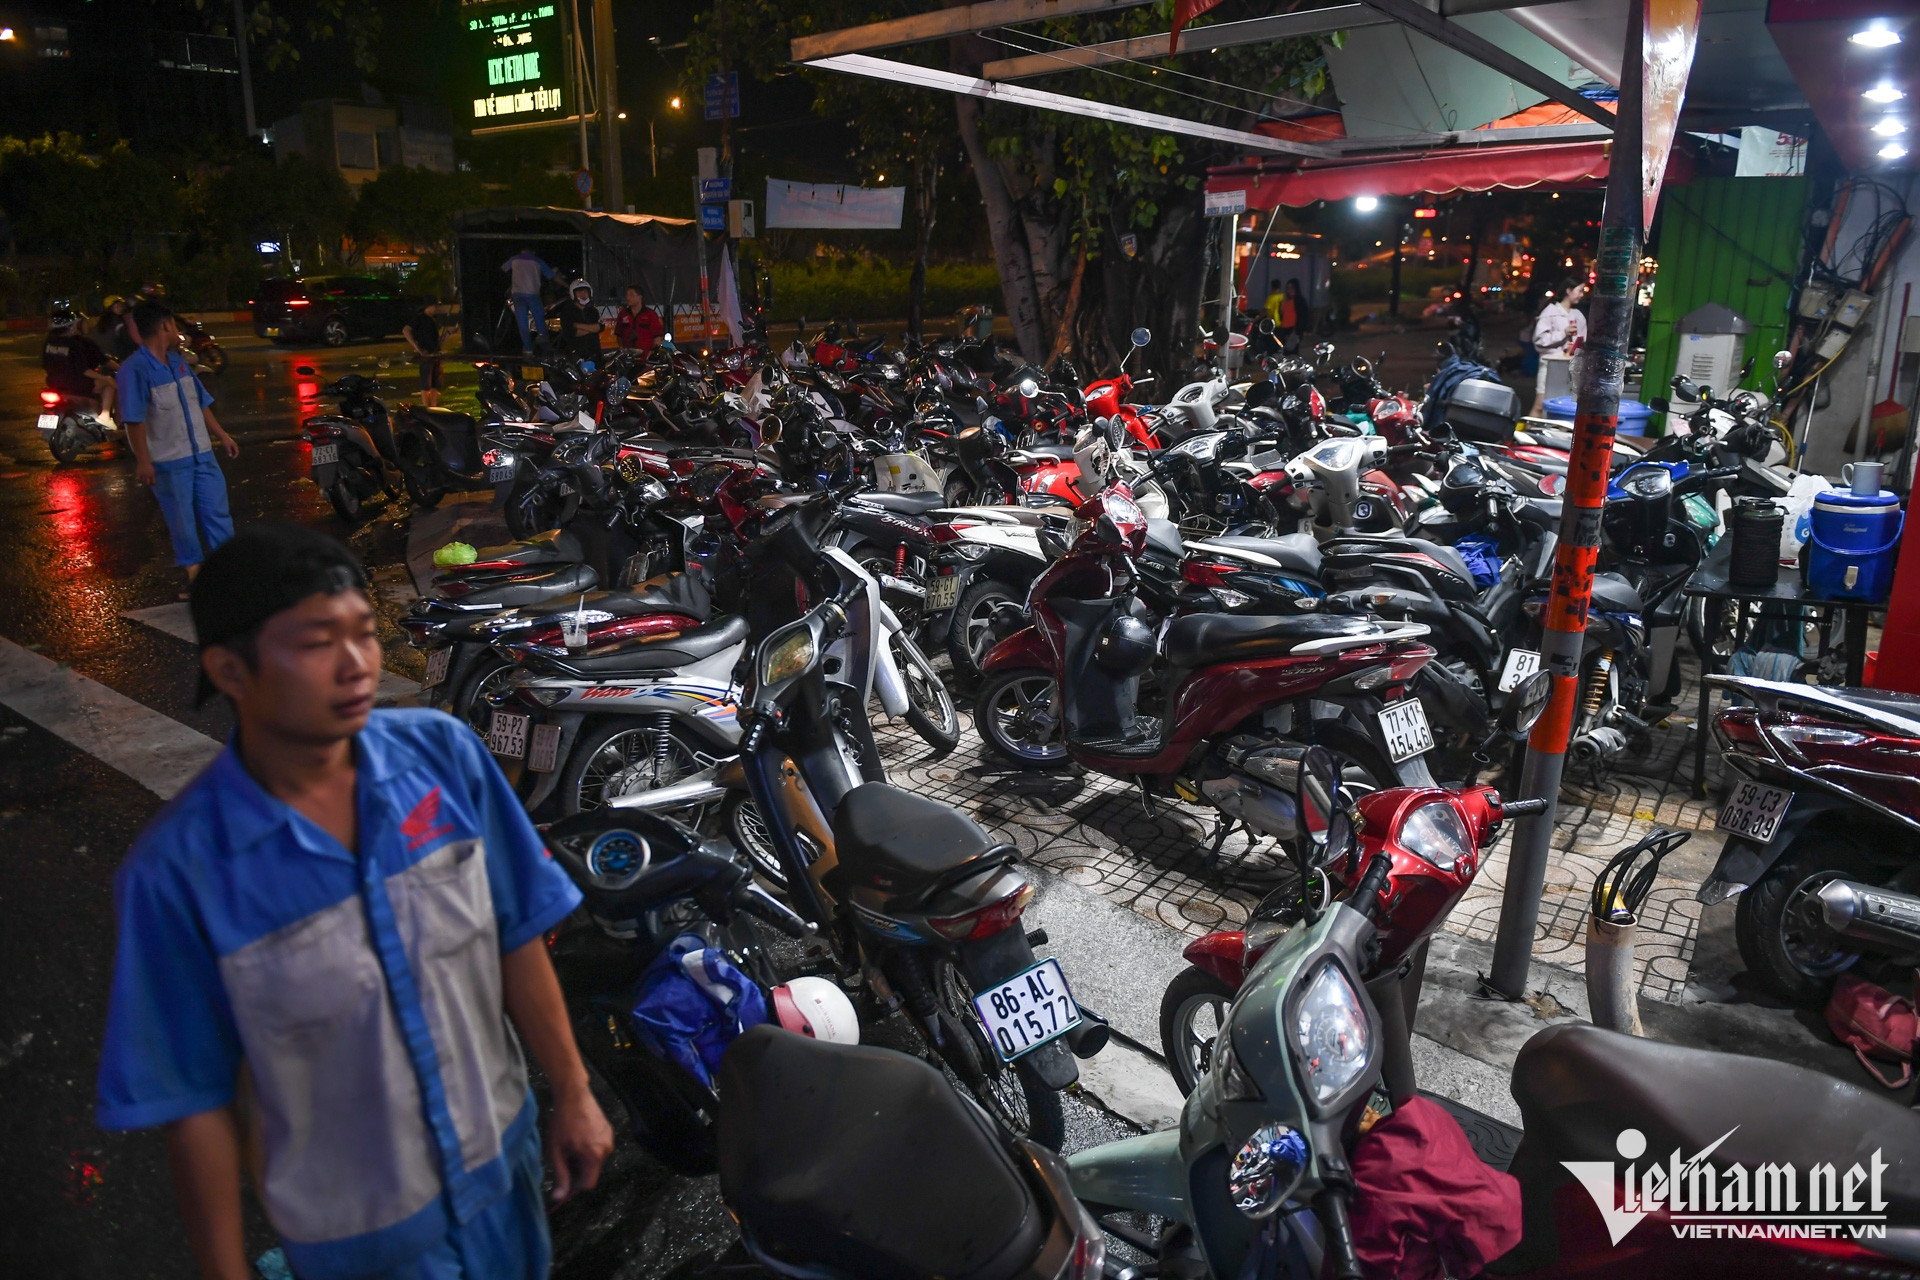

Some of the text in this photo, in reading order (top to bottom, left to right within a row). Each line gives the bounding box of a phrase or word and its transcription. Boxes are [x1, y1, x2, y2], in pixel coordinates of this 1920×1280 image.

[926, 592, 956, 611] 670.55
[496, 714, 523, 735] 59-P2
[1386, 704, 1419, 734] 77-K1
[490, 733, 524, 756] 967.53
[1390, 726, 1430, 756] 154.46
[1737, 783, 1782, 813] 59-C3
[990, 969, 1055, 1019] 86-AC
[996, 995, 1077, 1055] 015.72
